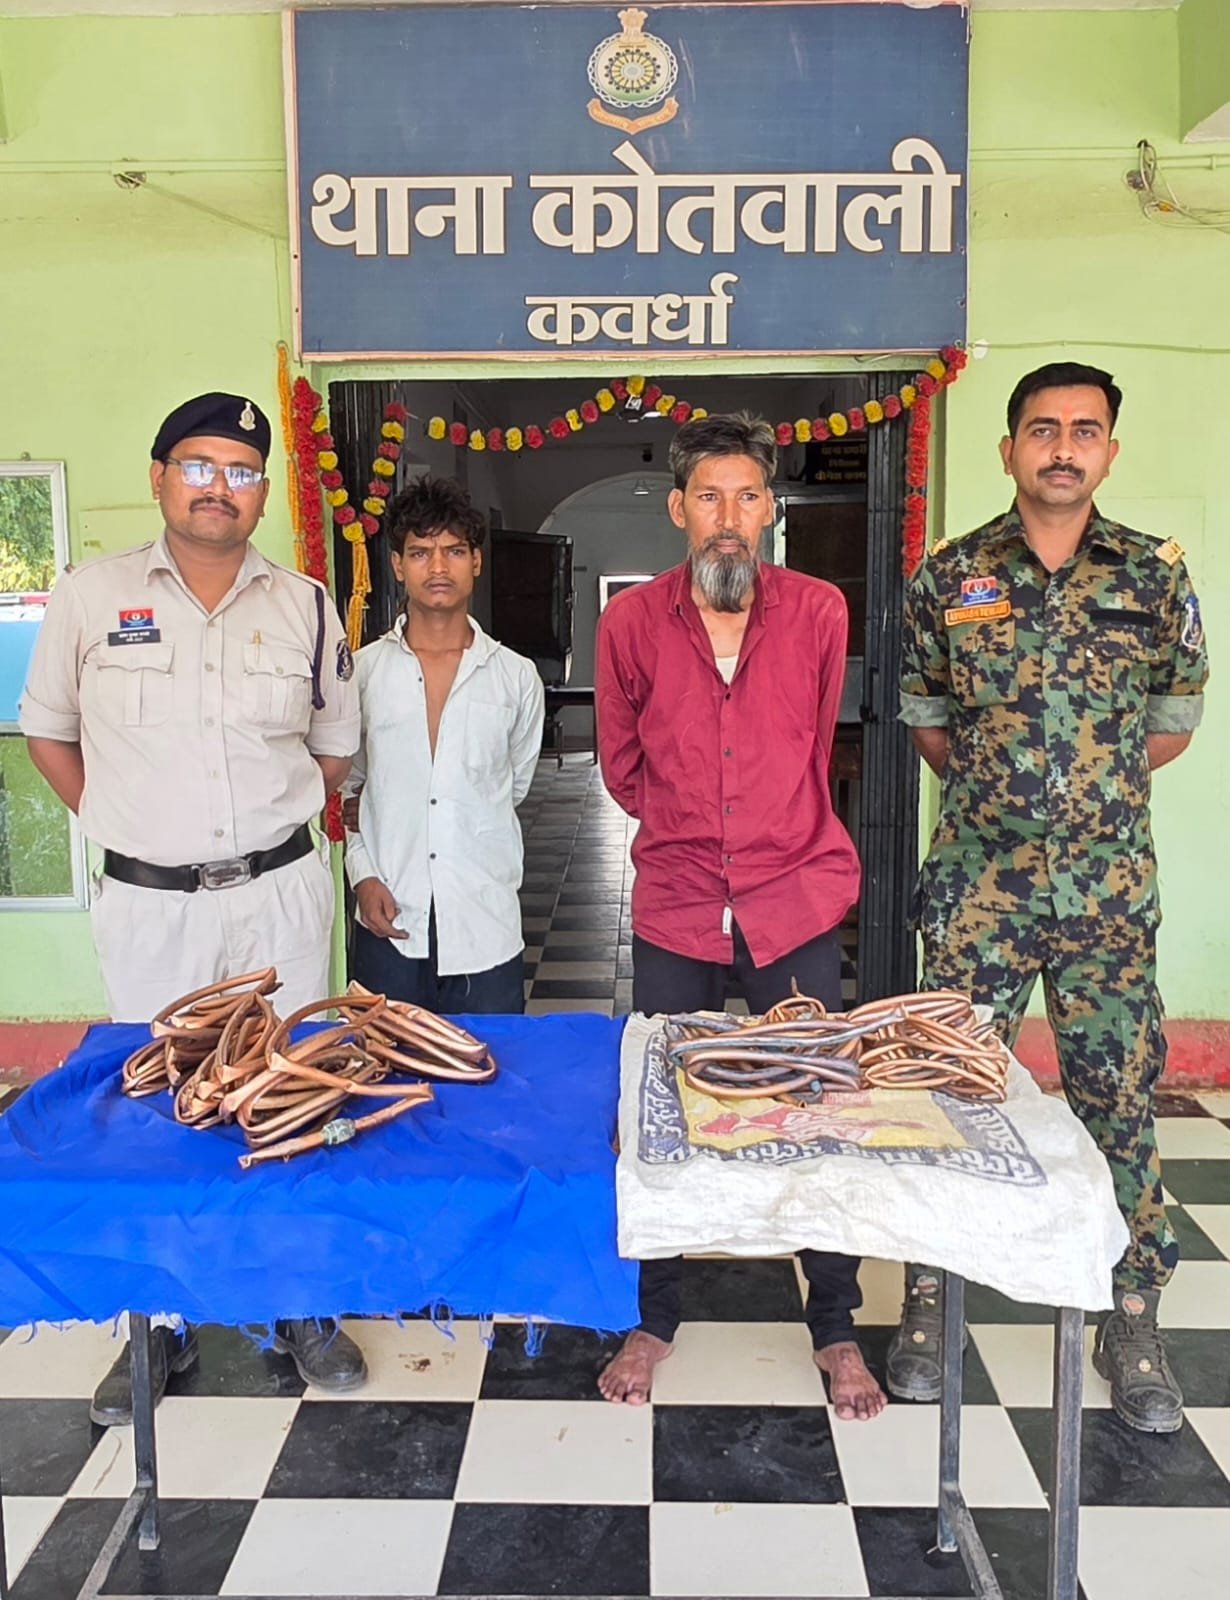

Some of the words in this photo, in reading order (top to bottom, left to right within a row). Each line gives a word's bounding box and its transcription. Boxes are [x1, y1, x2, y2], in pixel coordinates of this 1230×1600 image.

[310, 173, 513, 255] थाना
[530, 138, 962, 254] कोतवाली
[525, 272, 738, 345] कवर्धा
